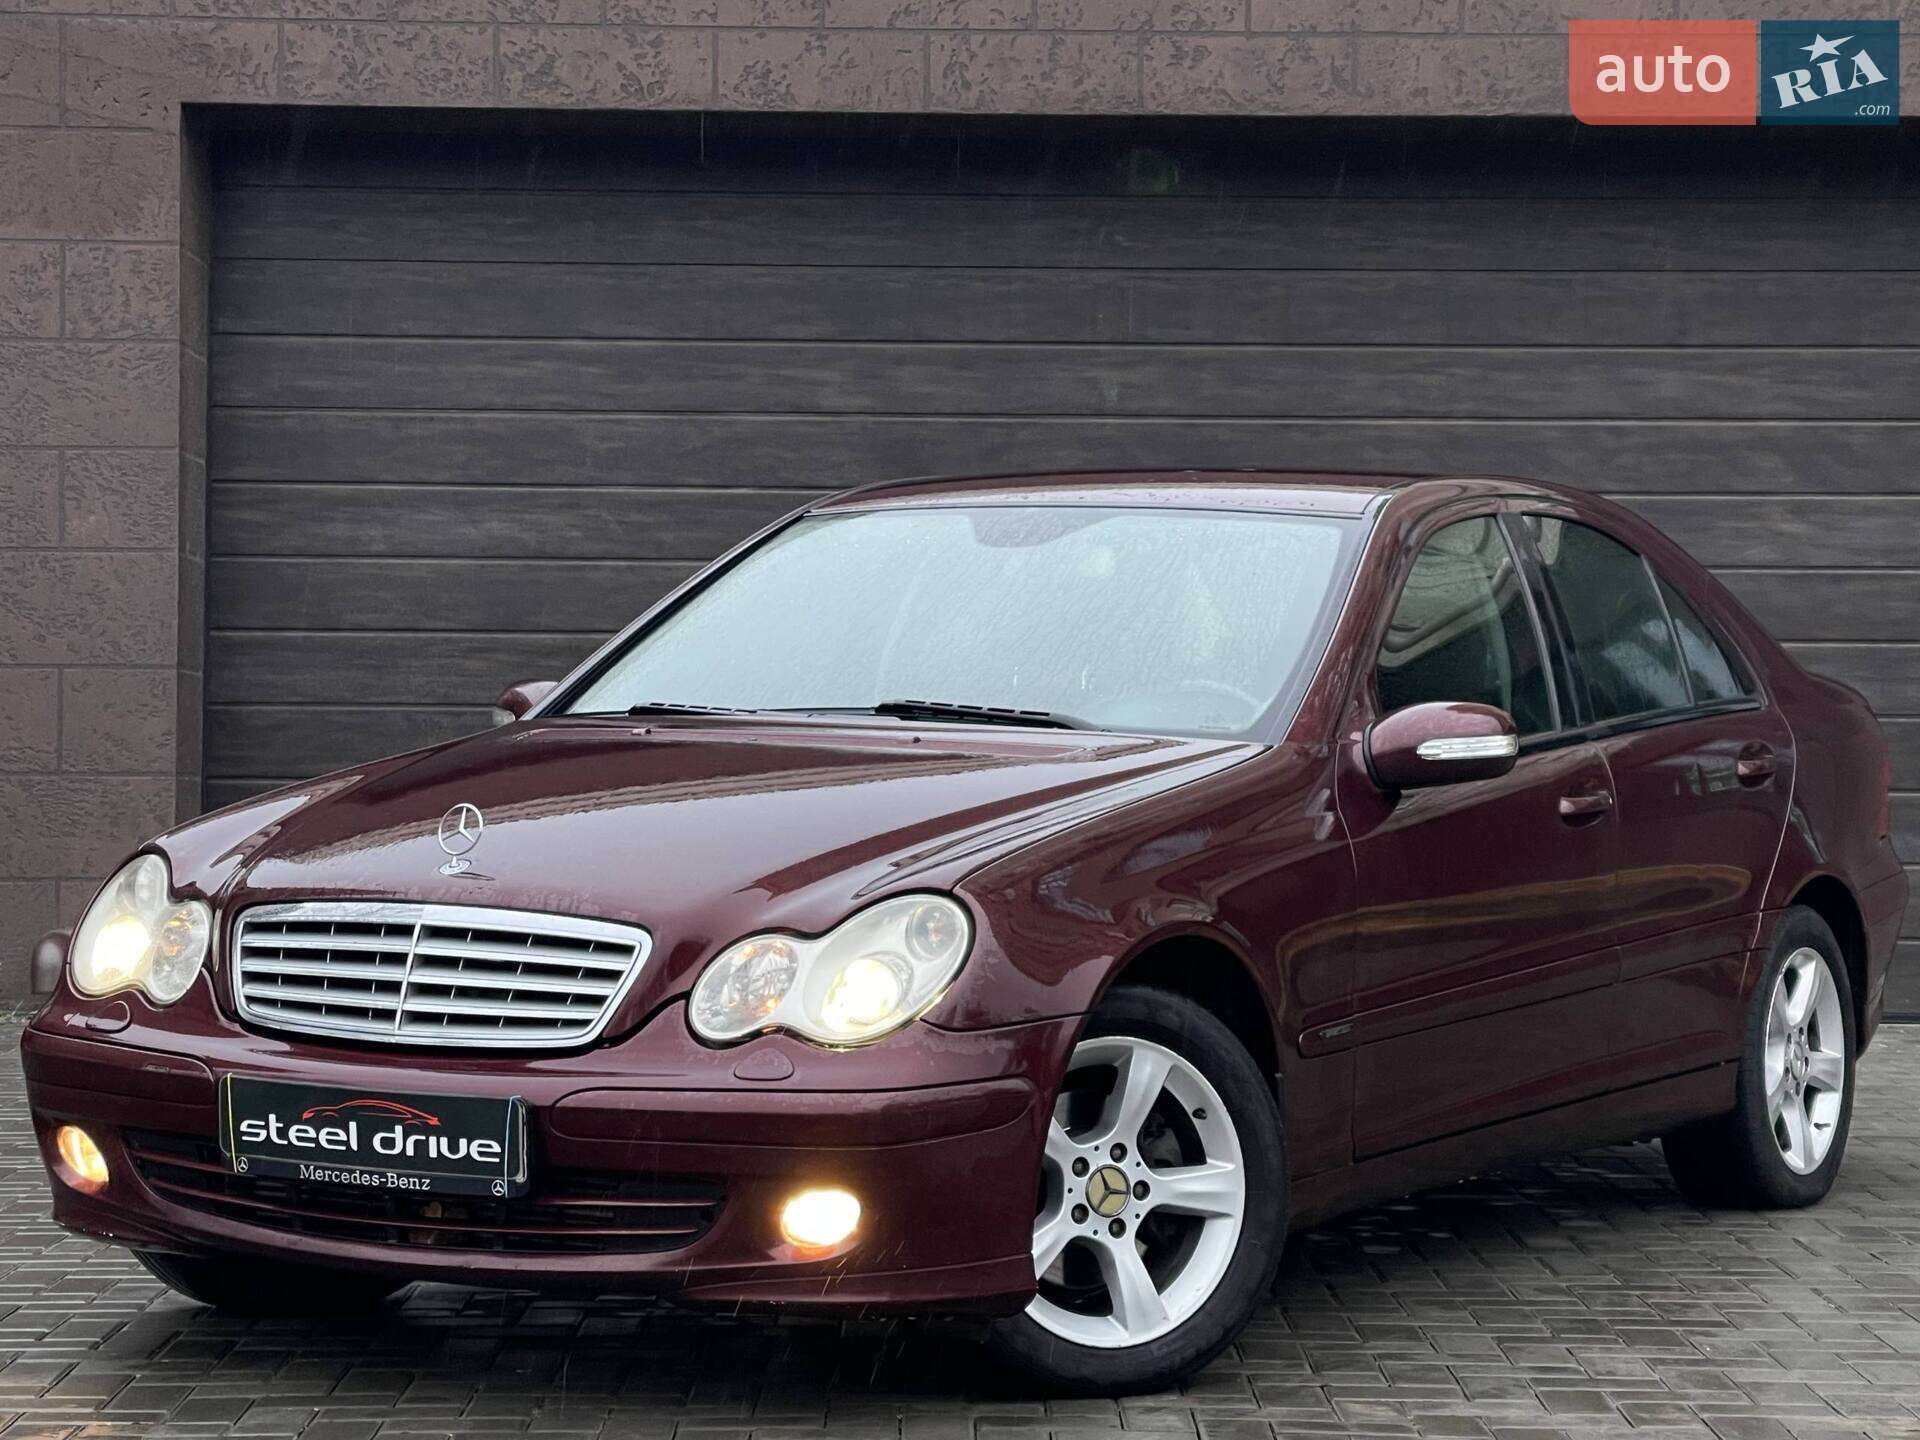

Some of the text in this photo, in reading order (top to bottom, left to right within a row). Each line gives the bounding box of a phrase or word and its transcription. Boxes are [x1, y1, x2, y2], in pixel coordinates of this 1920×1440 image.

[240, 1114, 501, 1162] steel drive
[300, 1165, 431, 1190] Mercedes-Benz
